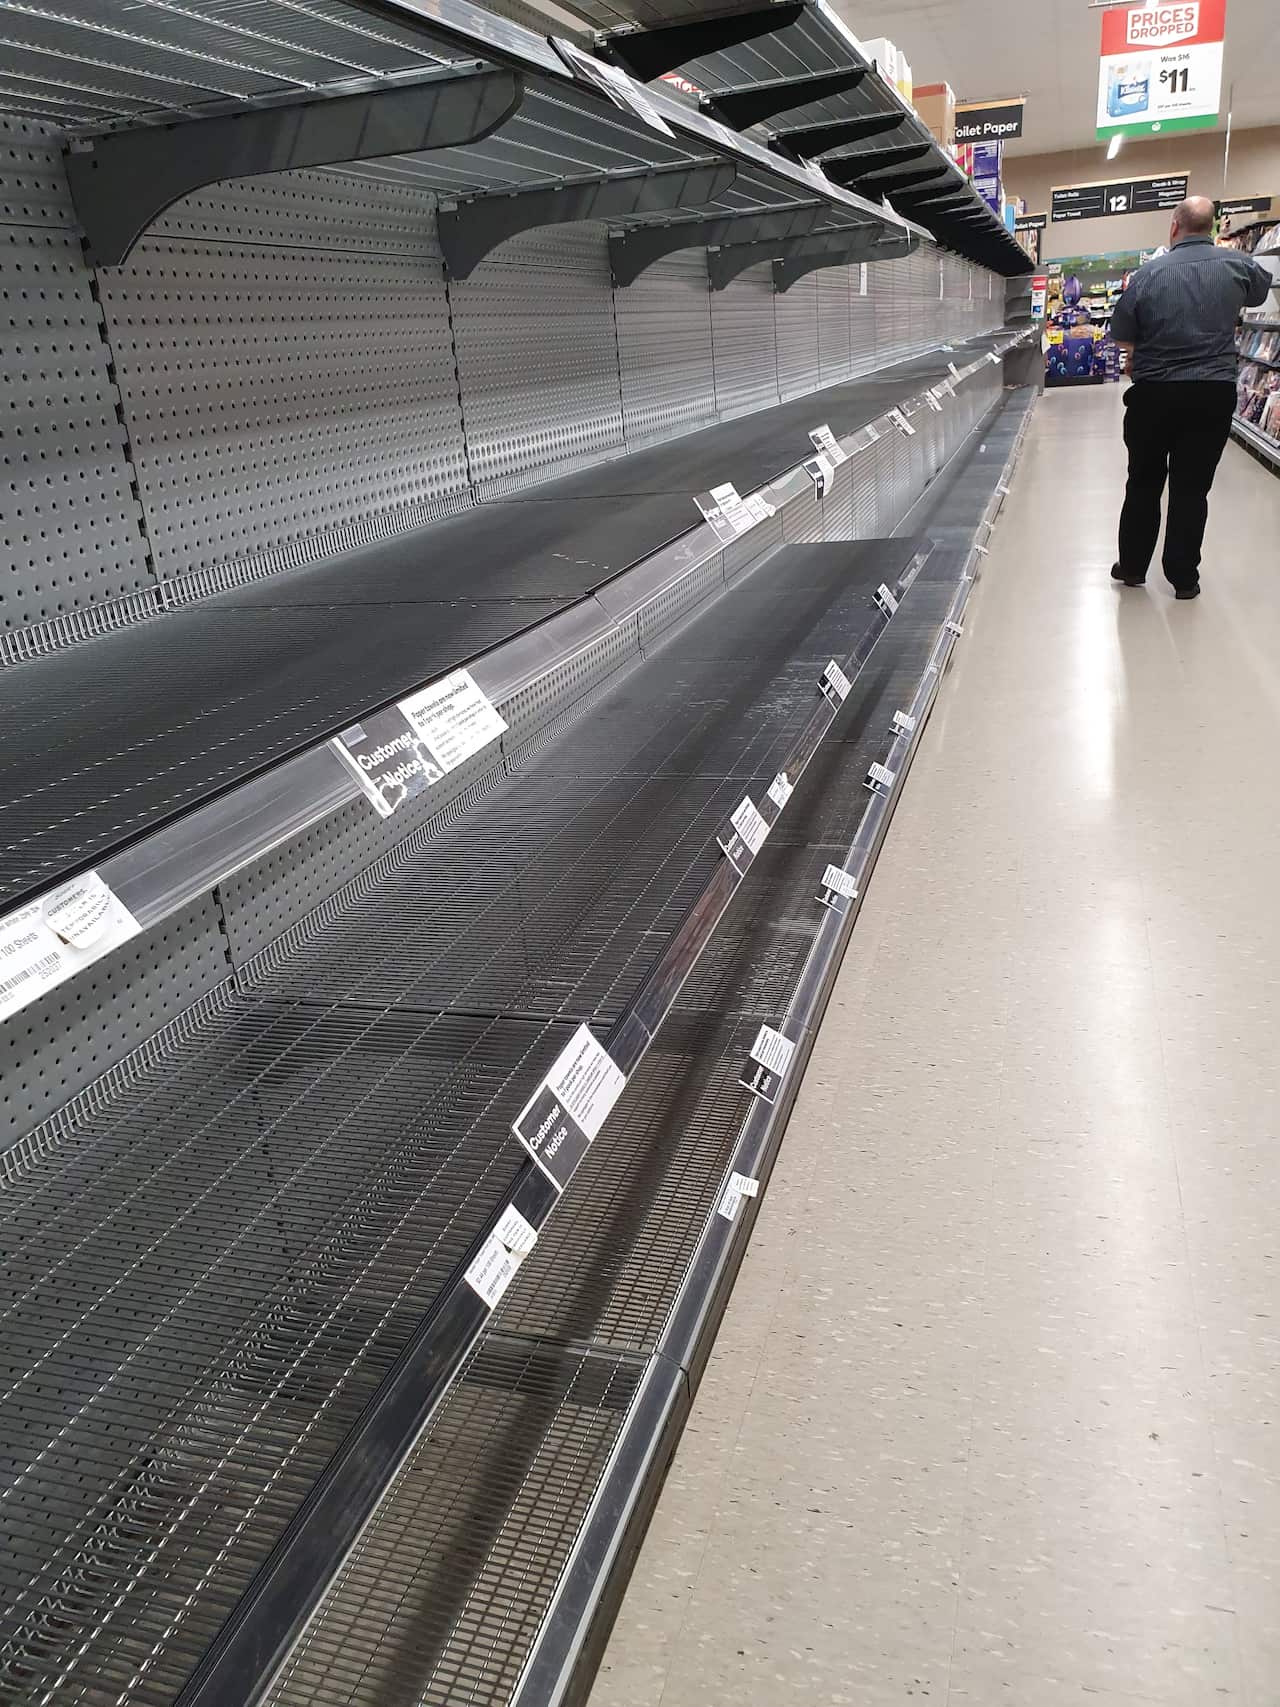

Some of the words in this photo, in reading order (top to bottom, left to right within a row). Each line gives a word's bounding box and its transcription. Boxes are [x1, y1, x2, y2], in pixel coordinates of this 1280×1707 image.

[1131, 7, 1194, 28] PRICES
[1130, 22, 1194, 39] DROPPED
[1159, 67, 1188, 94] $11
[983, 122, 1018, 136] Paper
[1109, 195, 1127, 213] 12
[357, 731, 413, 771] Customer
[381, 759, 422, 789] Notice
[13, 932, 39, 949] Sheets
[530, 1104, 560, 1150] Customer
[544, 1126, 568, 1159] Notice
